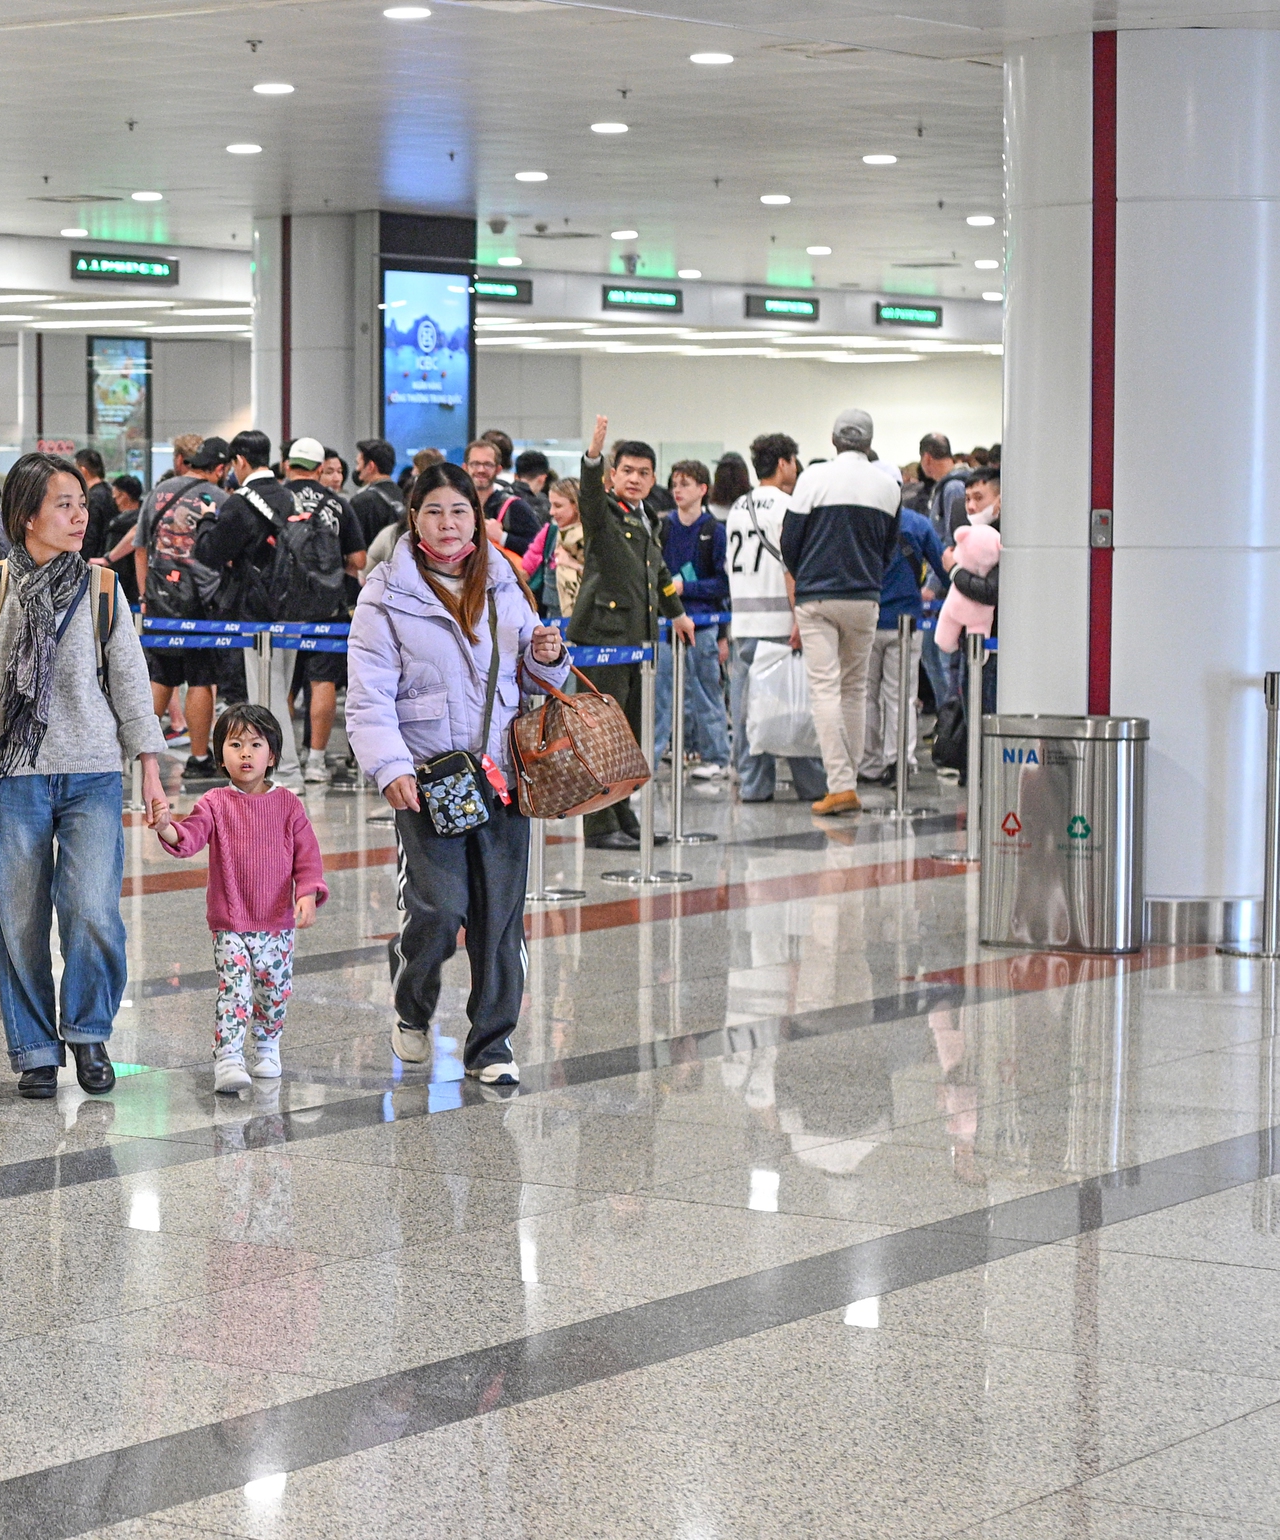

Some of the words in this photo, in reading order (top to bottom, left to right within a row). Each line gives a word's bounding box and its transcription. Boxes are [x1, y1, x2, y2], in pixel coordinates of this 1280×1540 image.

[730, 530, 766, 573] 27
[269, 625, 285, 633] ACV
[300, 640, 316, 648] ACV
[1003, 749, 1039, 764] NIA
